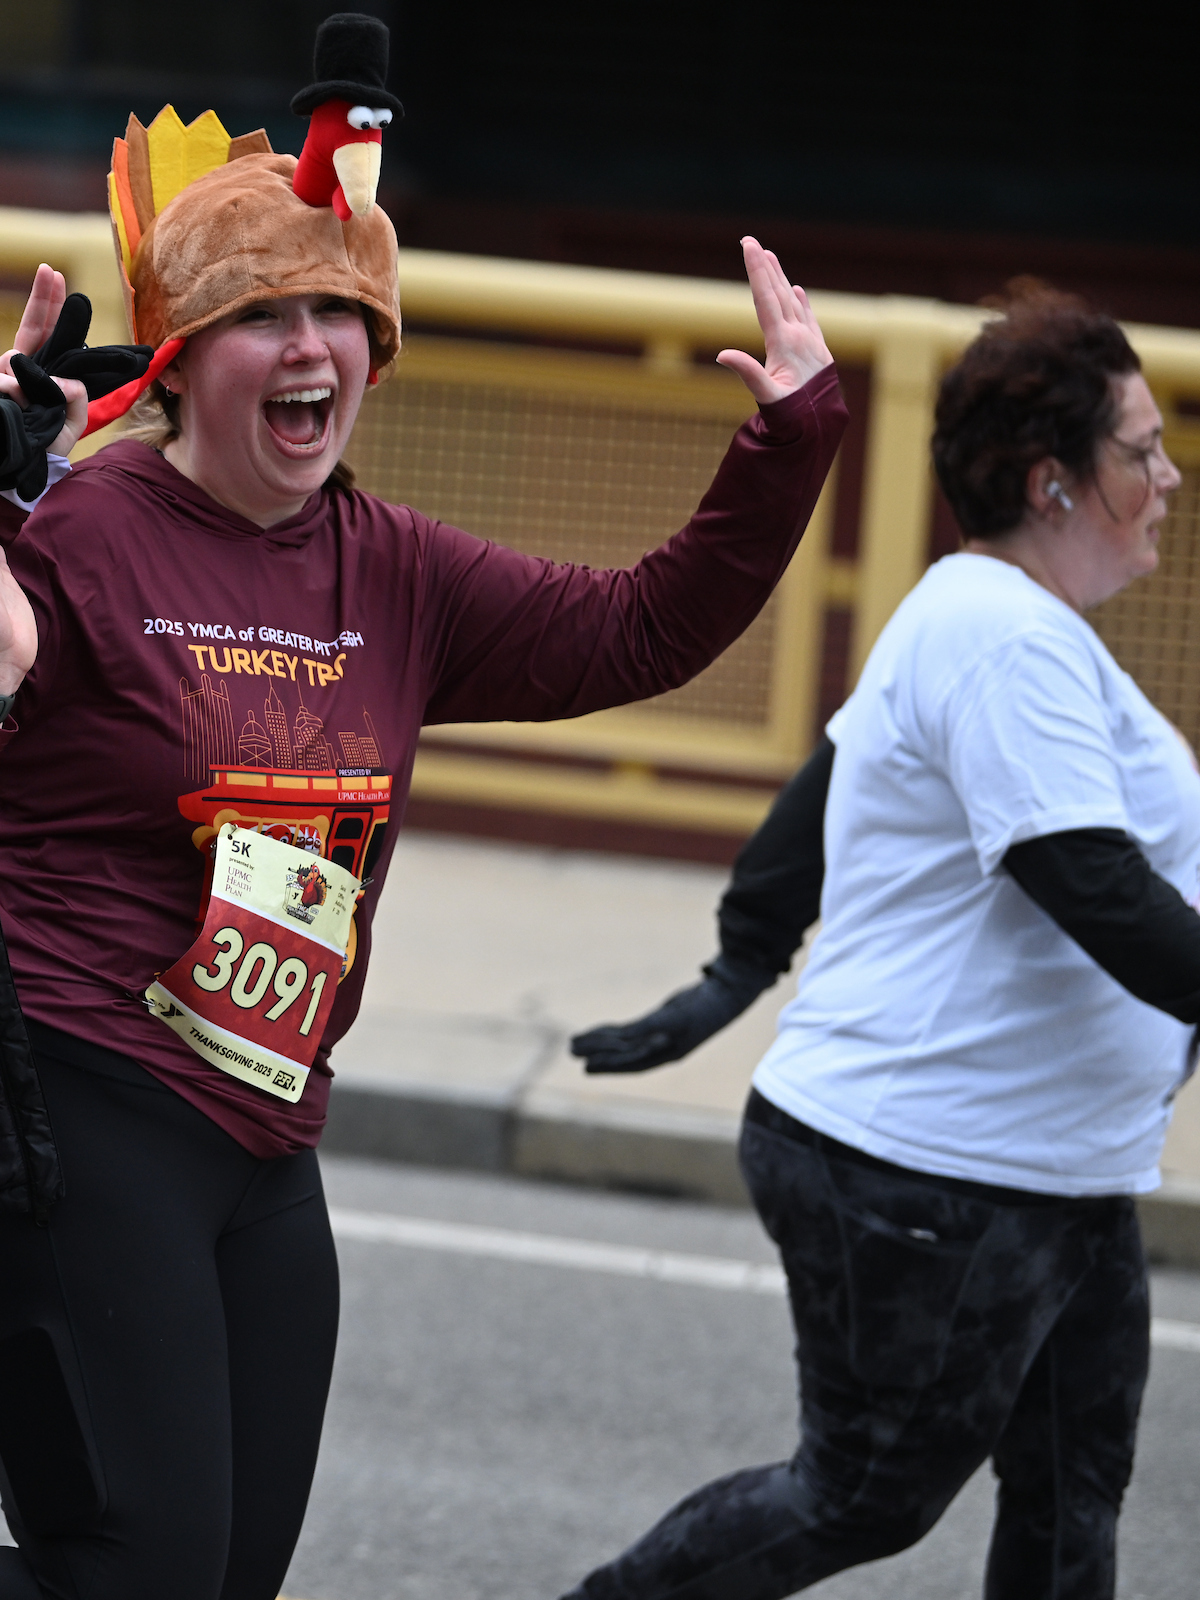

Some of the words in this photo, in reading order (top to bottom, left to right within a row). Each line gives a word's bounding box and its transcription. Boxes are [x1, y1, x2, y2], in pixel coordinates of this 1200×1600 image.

[143, 618, 185, 636] 2025
[187, 621, 236, 640] YMCA
[238, 626, 254, 641] of
[258, 625, 314, 653] GREATER
[187, 644, 298, 681] TURKEY
[338, 768, 365, 776] PRESENTED
[337, 791, 358, 801] UPMC
[231, 840, 252, 858] 5K
[229, 857, 250, 868] presented
[228, 866, 252, 883] UPMC
[191, 926, 328, 1037] 3091
[189, 1027, 253, 1069] THANKSGIVING
[253, 1062, 273, 1077] 2025
